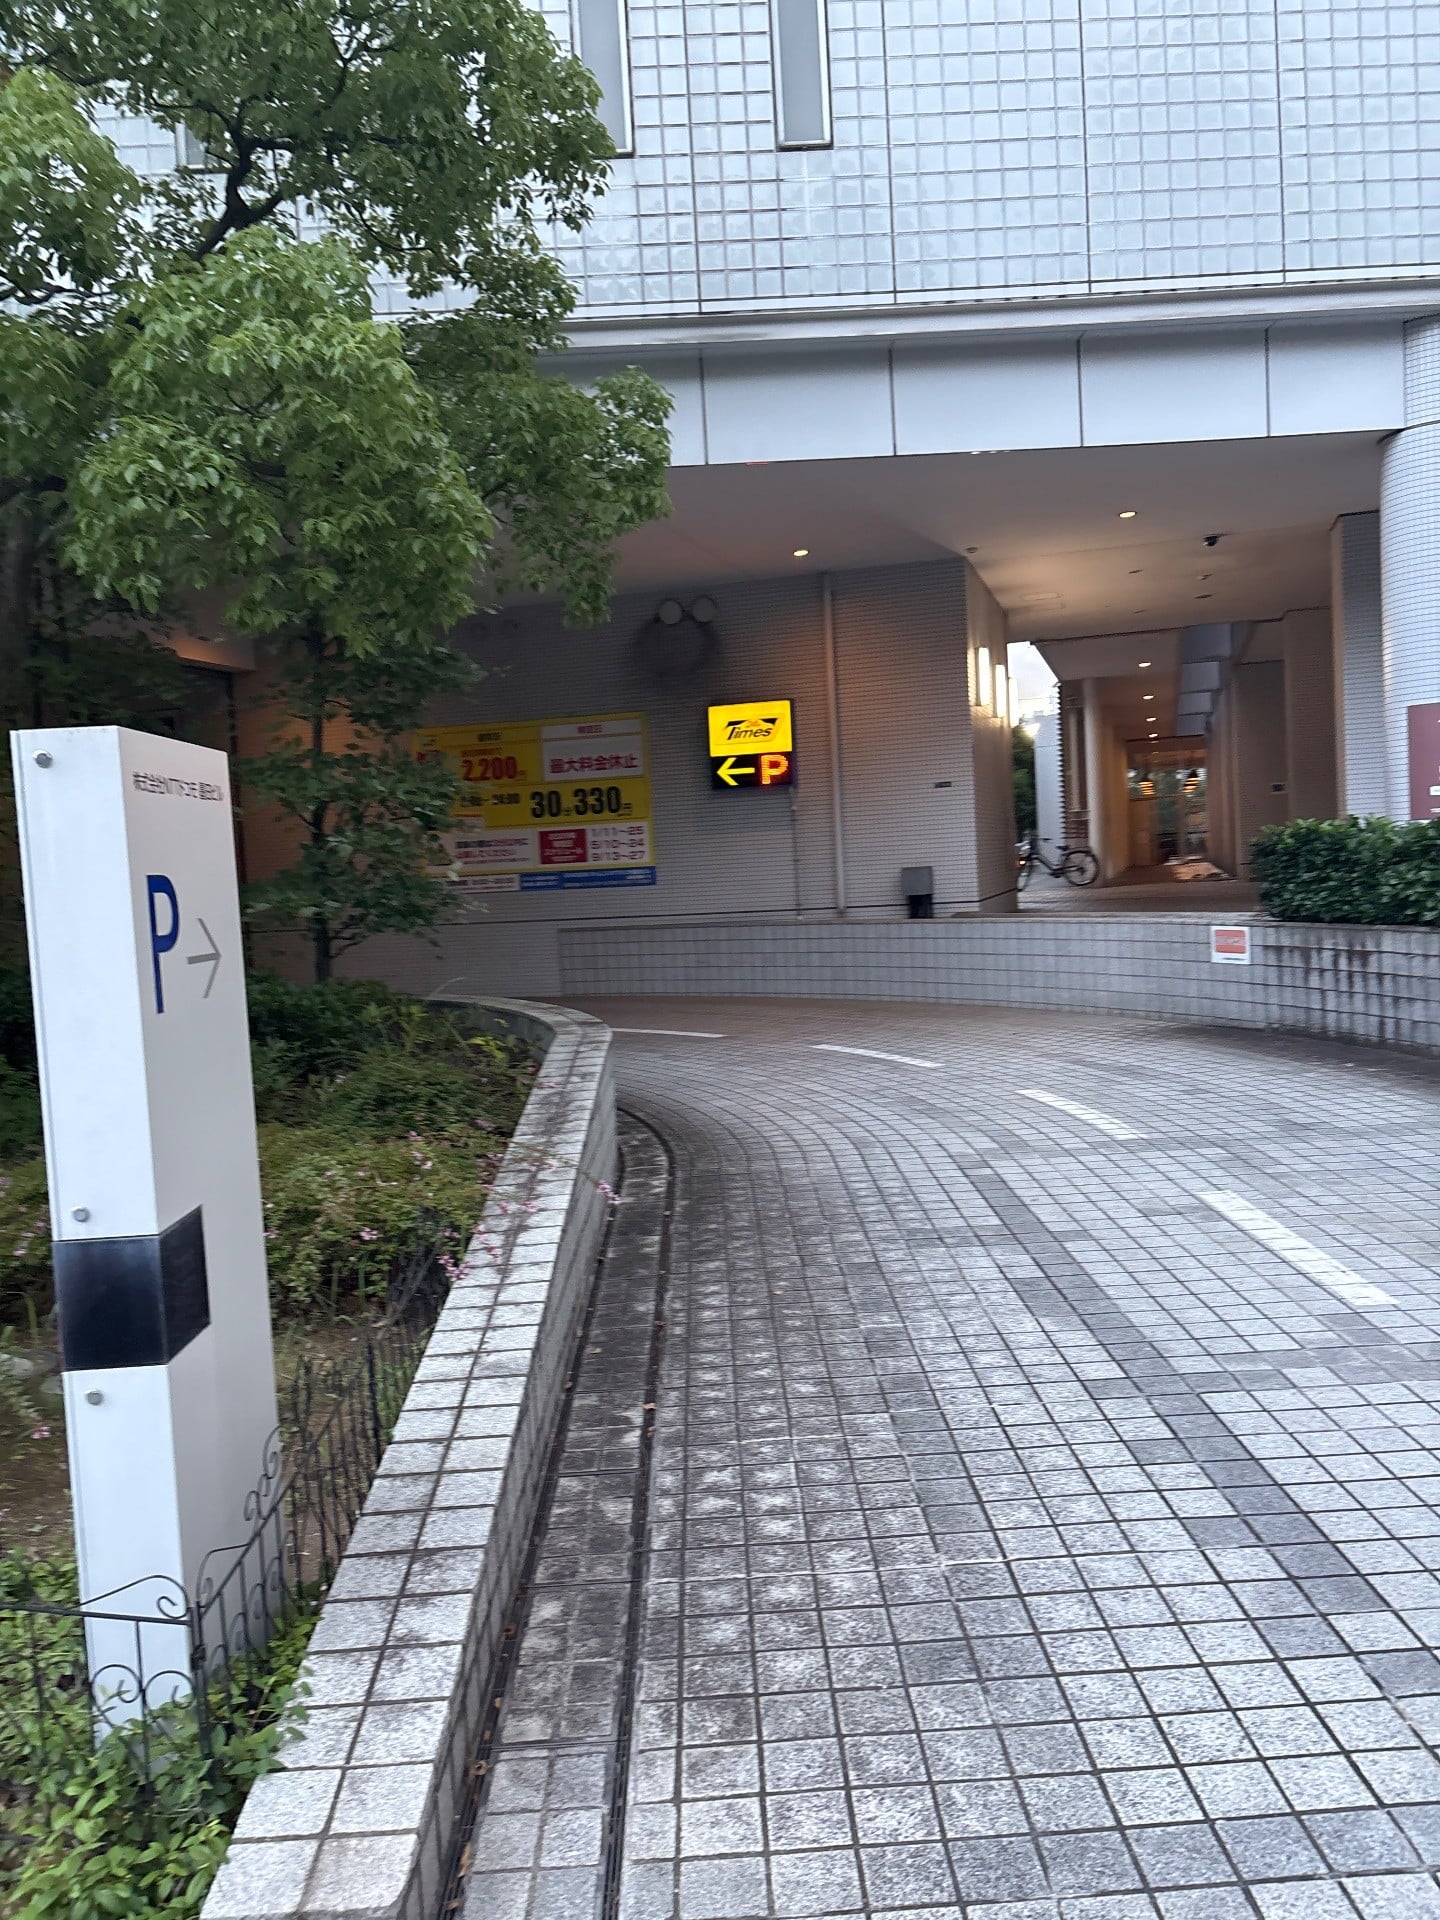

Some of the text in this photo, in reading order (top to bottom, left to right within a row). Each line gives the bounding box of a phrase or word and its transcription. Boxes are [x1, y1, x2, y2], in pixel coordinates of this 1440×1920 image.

[726, 721, 775, 741] Times
[761, 754, 789, 784] P
[145, 874, 180, 1014] P
